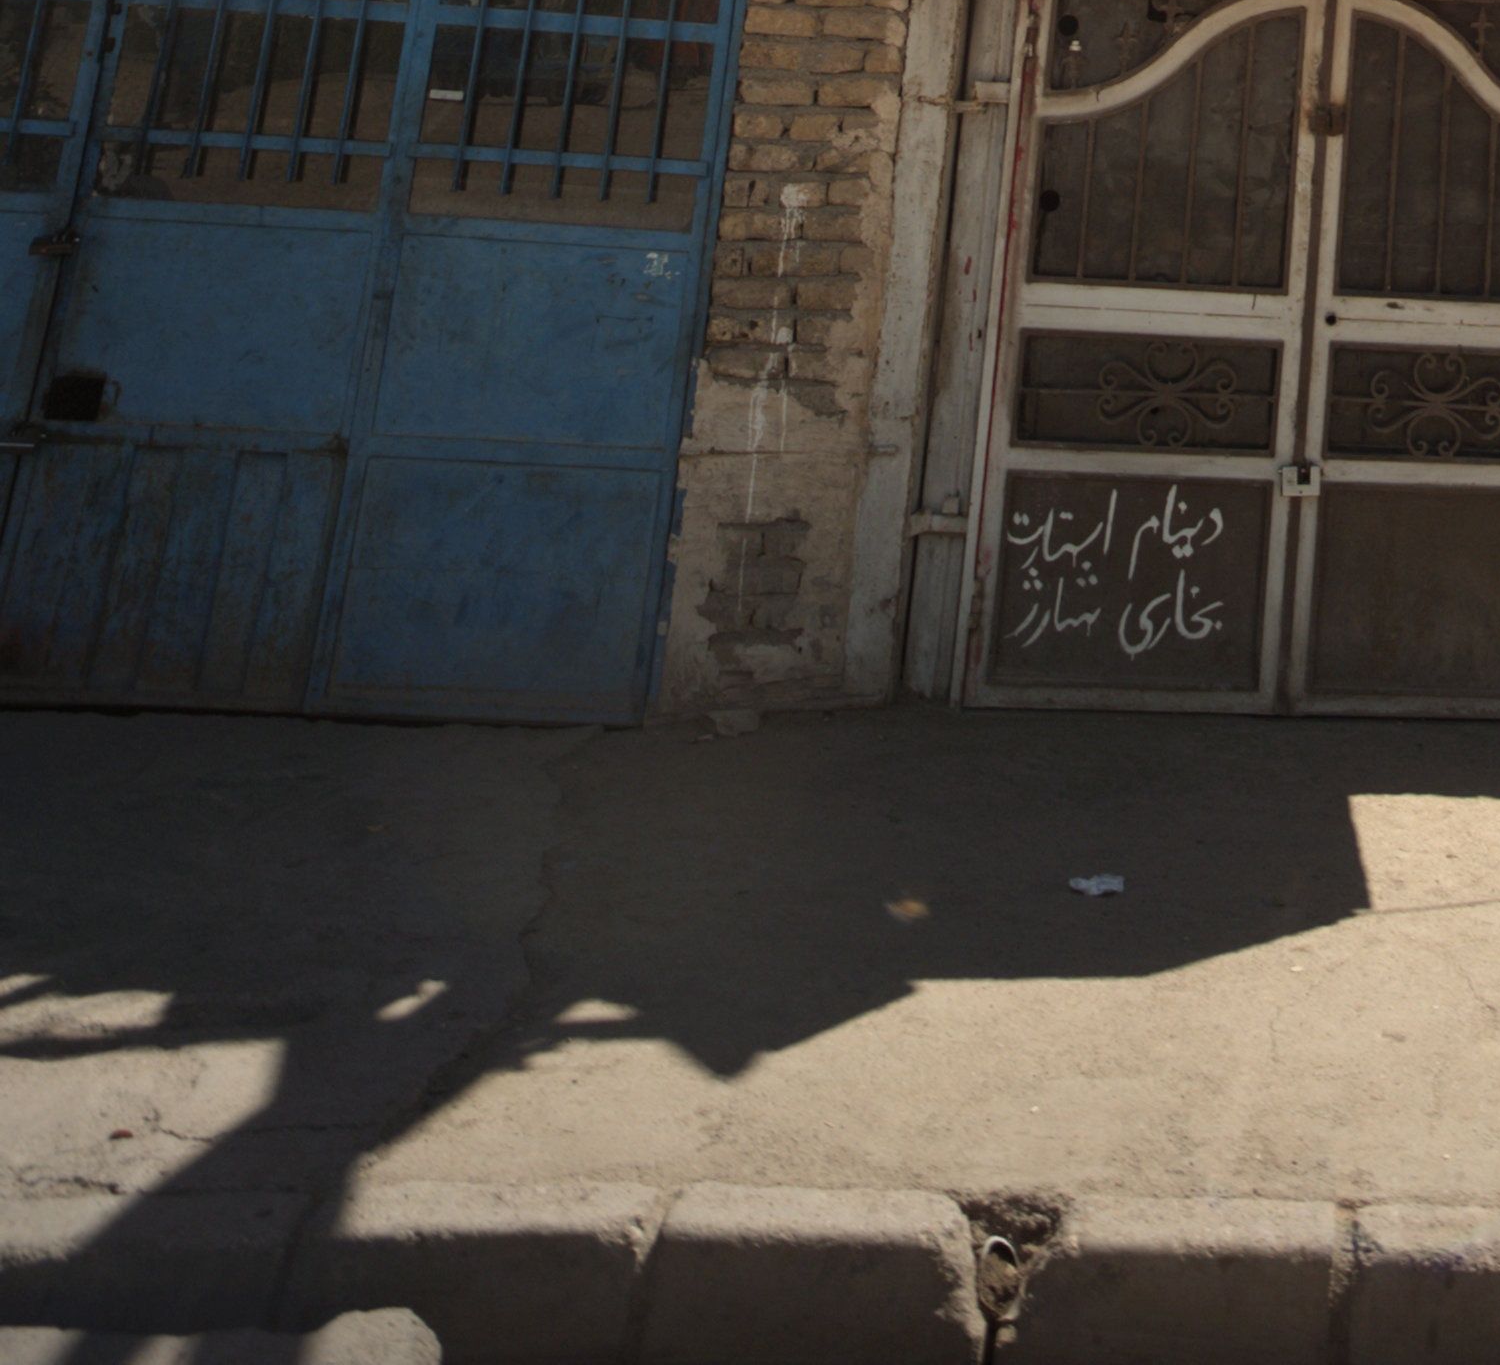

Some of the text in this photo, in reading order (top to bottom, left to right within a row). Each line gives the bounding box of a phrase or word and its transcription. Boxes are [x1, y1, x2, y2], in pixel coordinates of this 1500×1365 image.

[1006, 483, 1224, 581] دینام استارت
[1003, 560, 1225, 657] بخاری شارژ
